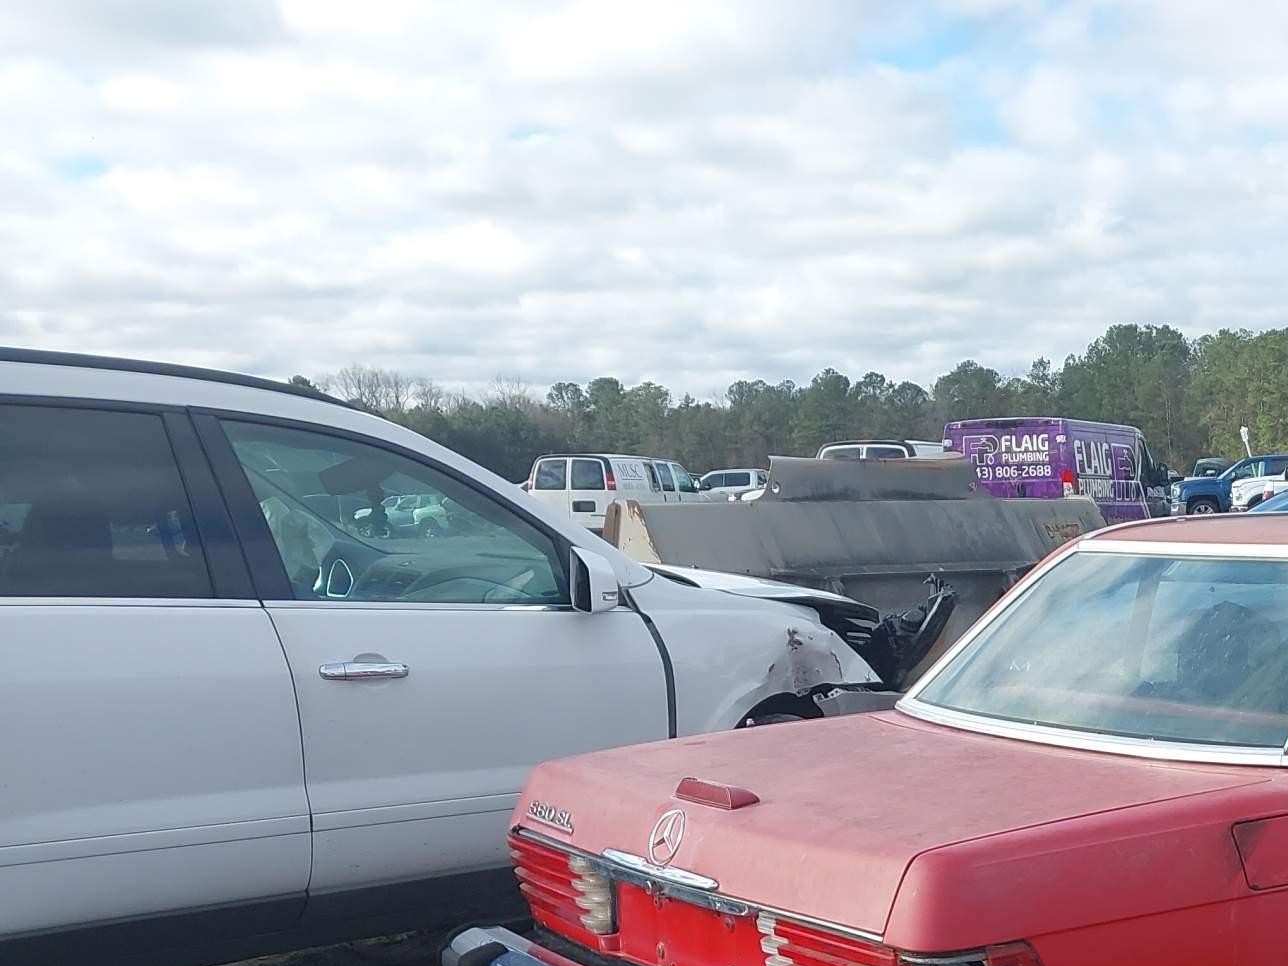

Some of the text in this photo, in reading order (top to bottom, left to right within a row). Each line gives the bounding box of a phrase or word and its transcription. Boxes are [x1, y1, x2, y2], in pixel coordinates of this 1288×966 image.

[1001, 434, 1049, 452] FLAIG
[1002, 452, 1049, 463] PLUMBING
[1073, 439, 1113, 475] FLAIG
[995, 465, 1052, 478] 806-2688
[1079, 479, 1115, 498] PLUMBING
